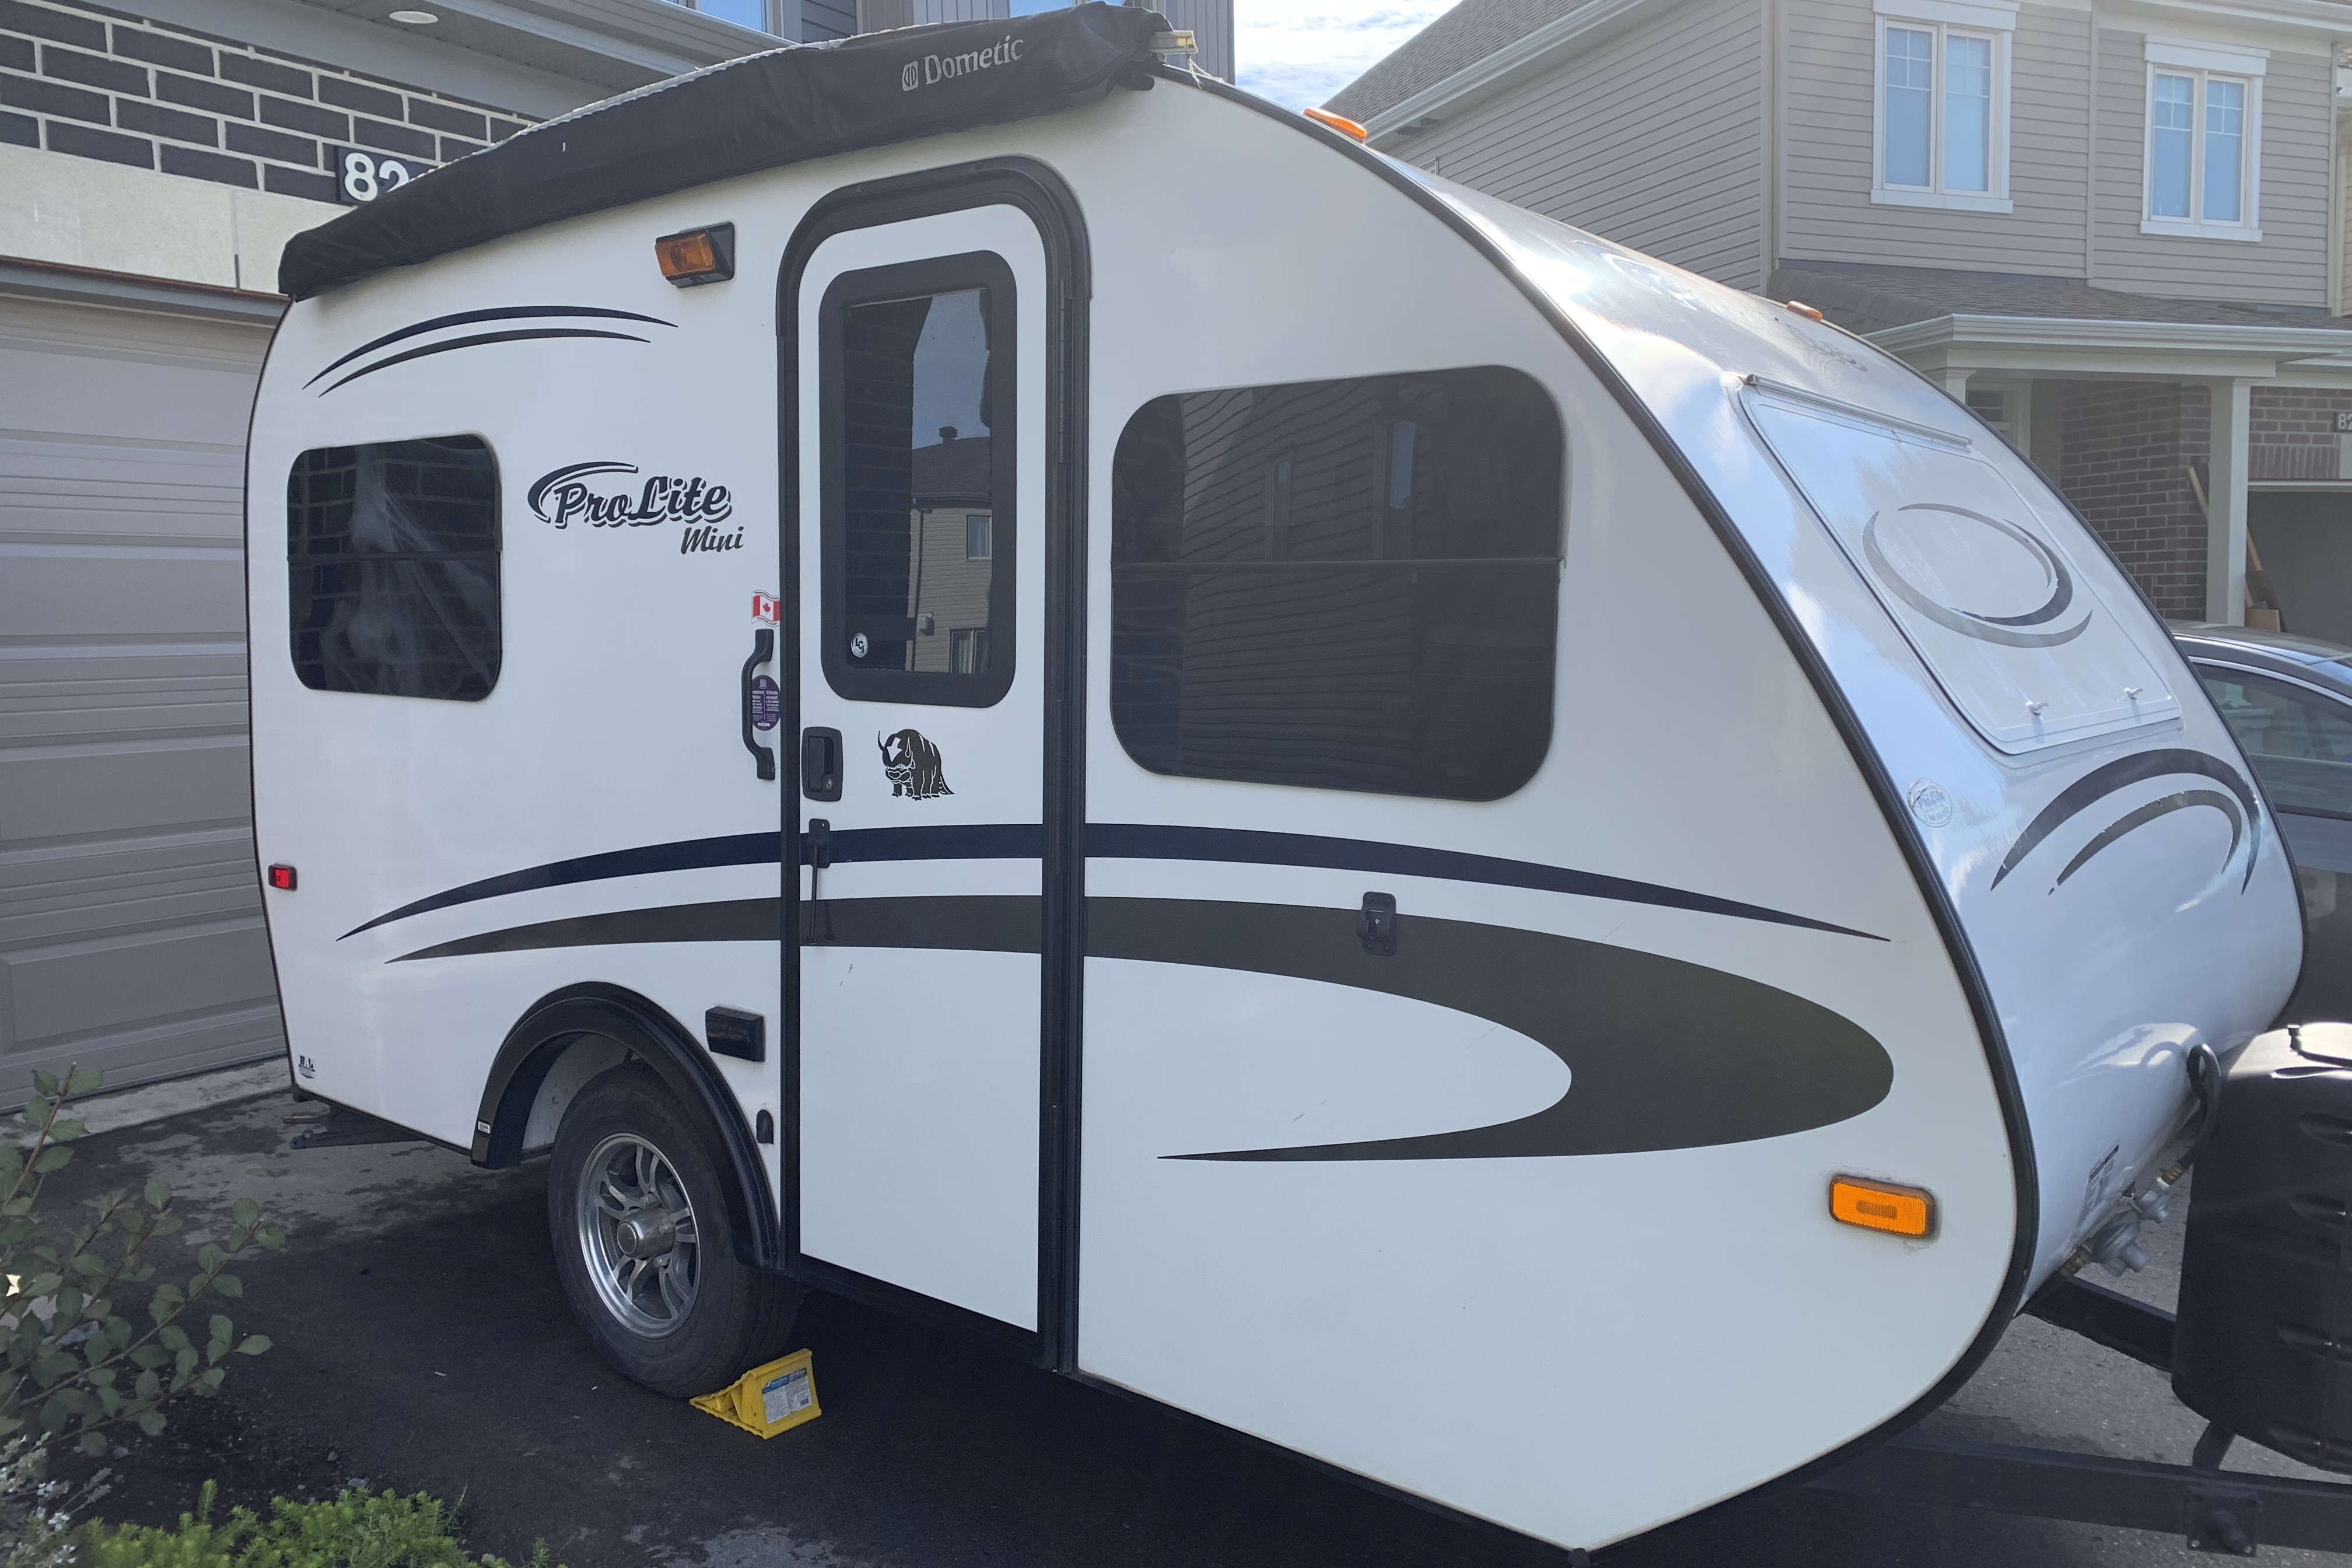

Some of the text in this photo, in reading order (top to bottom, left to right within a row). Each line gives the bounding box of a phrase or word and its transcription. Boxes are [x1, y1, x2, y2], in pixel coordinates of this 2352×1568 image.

[924, 34, 1023, 84] Dometic
[554, 475, 732, 530] ProLite
[680, 526, 744, 554] Mini
